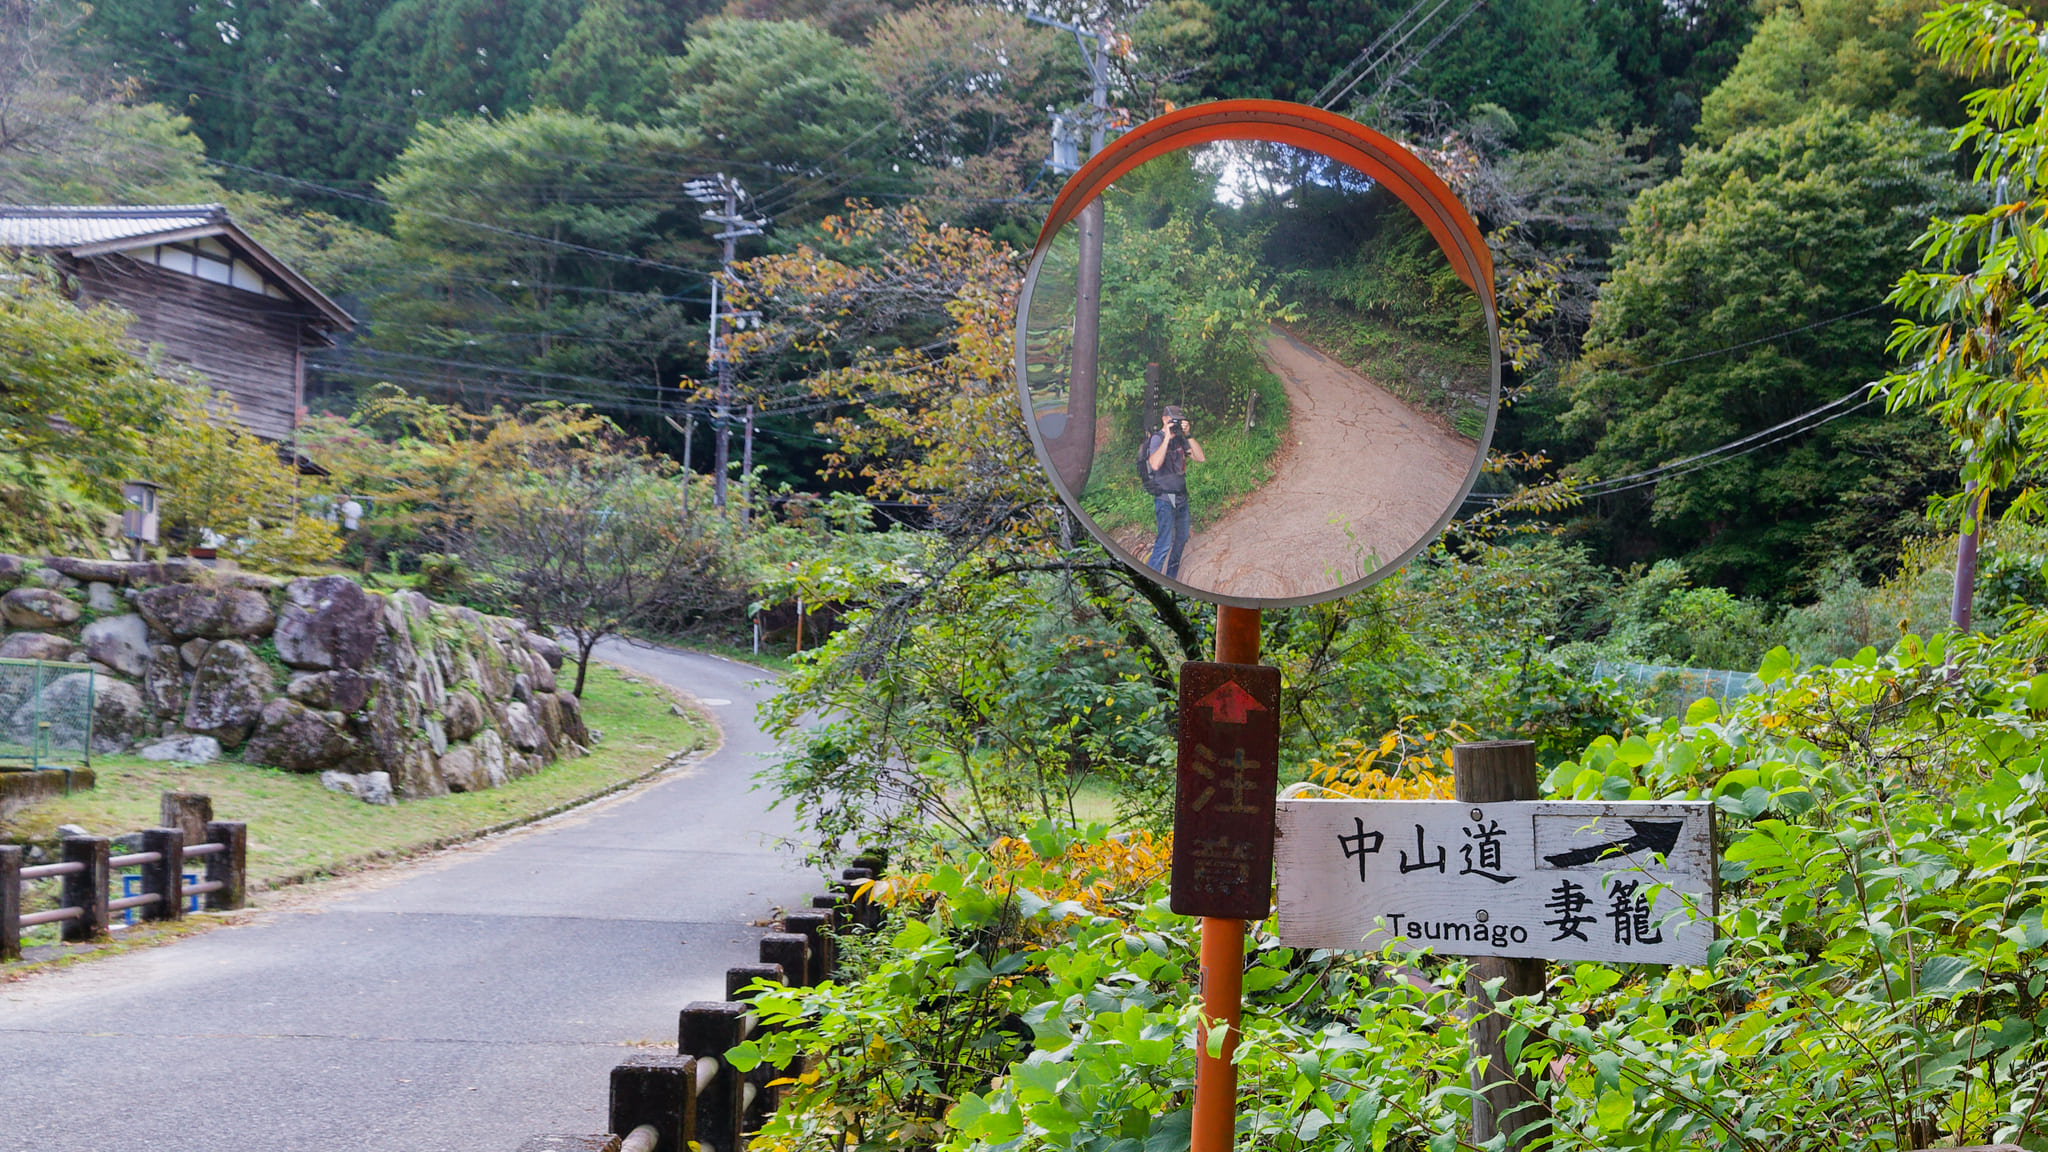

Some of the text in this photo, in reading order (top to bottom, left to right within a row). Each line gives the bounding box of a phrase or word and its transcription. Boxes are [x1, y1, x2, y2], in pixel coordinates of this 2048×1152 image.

[1337, 816, 1518, 885] 中山道
[1386, 912, 1529, 948] Tsumago
[1543, 878, 1663, 946] 妻籠
